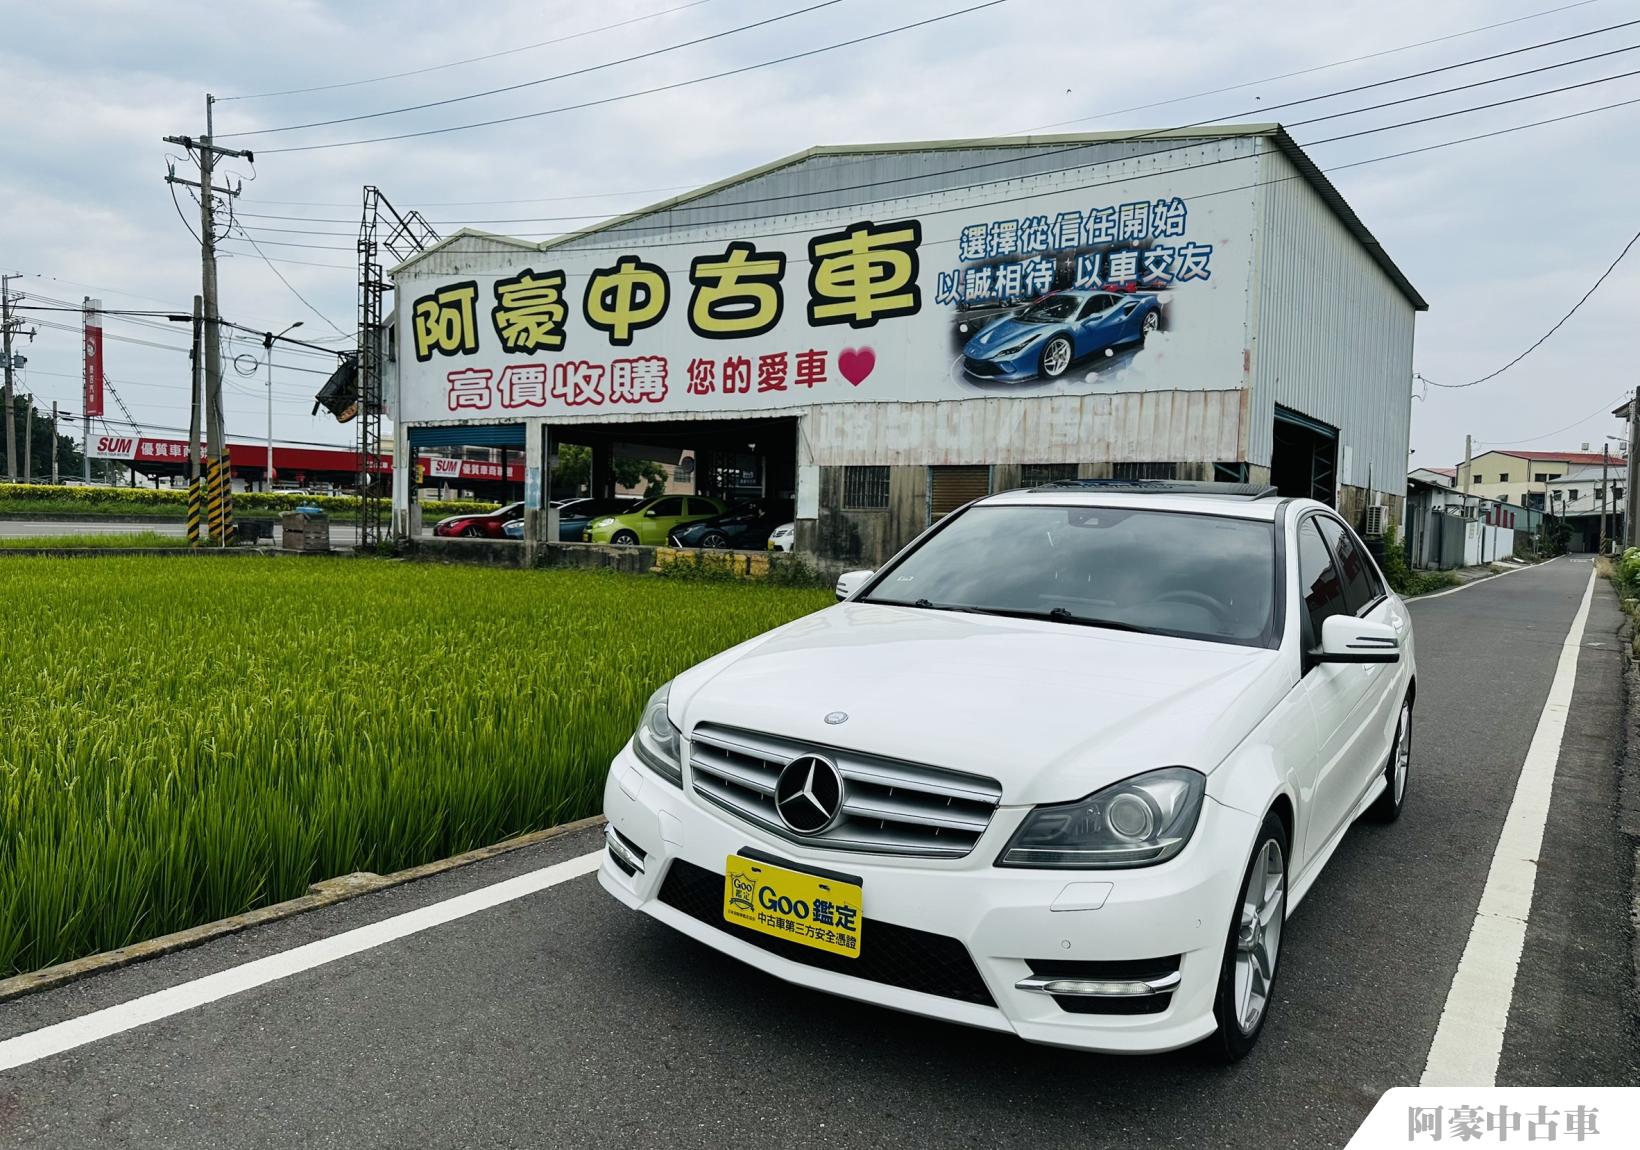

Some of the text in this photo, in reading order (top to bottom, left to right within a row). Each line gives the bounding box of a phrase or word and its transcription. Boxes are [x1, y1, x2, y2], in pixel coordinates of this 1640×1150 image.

[959, 197, 1188, 262] 選擇從信任開始
[412, 219, 922, 362] 阿豪中古車
[935, 243, 1213, 306] 以誠相待 以車交友
[446, 348, 829, 411] 高價收購 您的愛車
[97, 436, 133, 453] SUM
[435, 460, 458, 473] SUM
[733, 878, 753, 892] Goo
[758, 885, 857, 932] Goo 鑑定
[757, 912, 857, 950] 中古車第三方安全憑證
